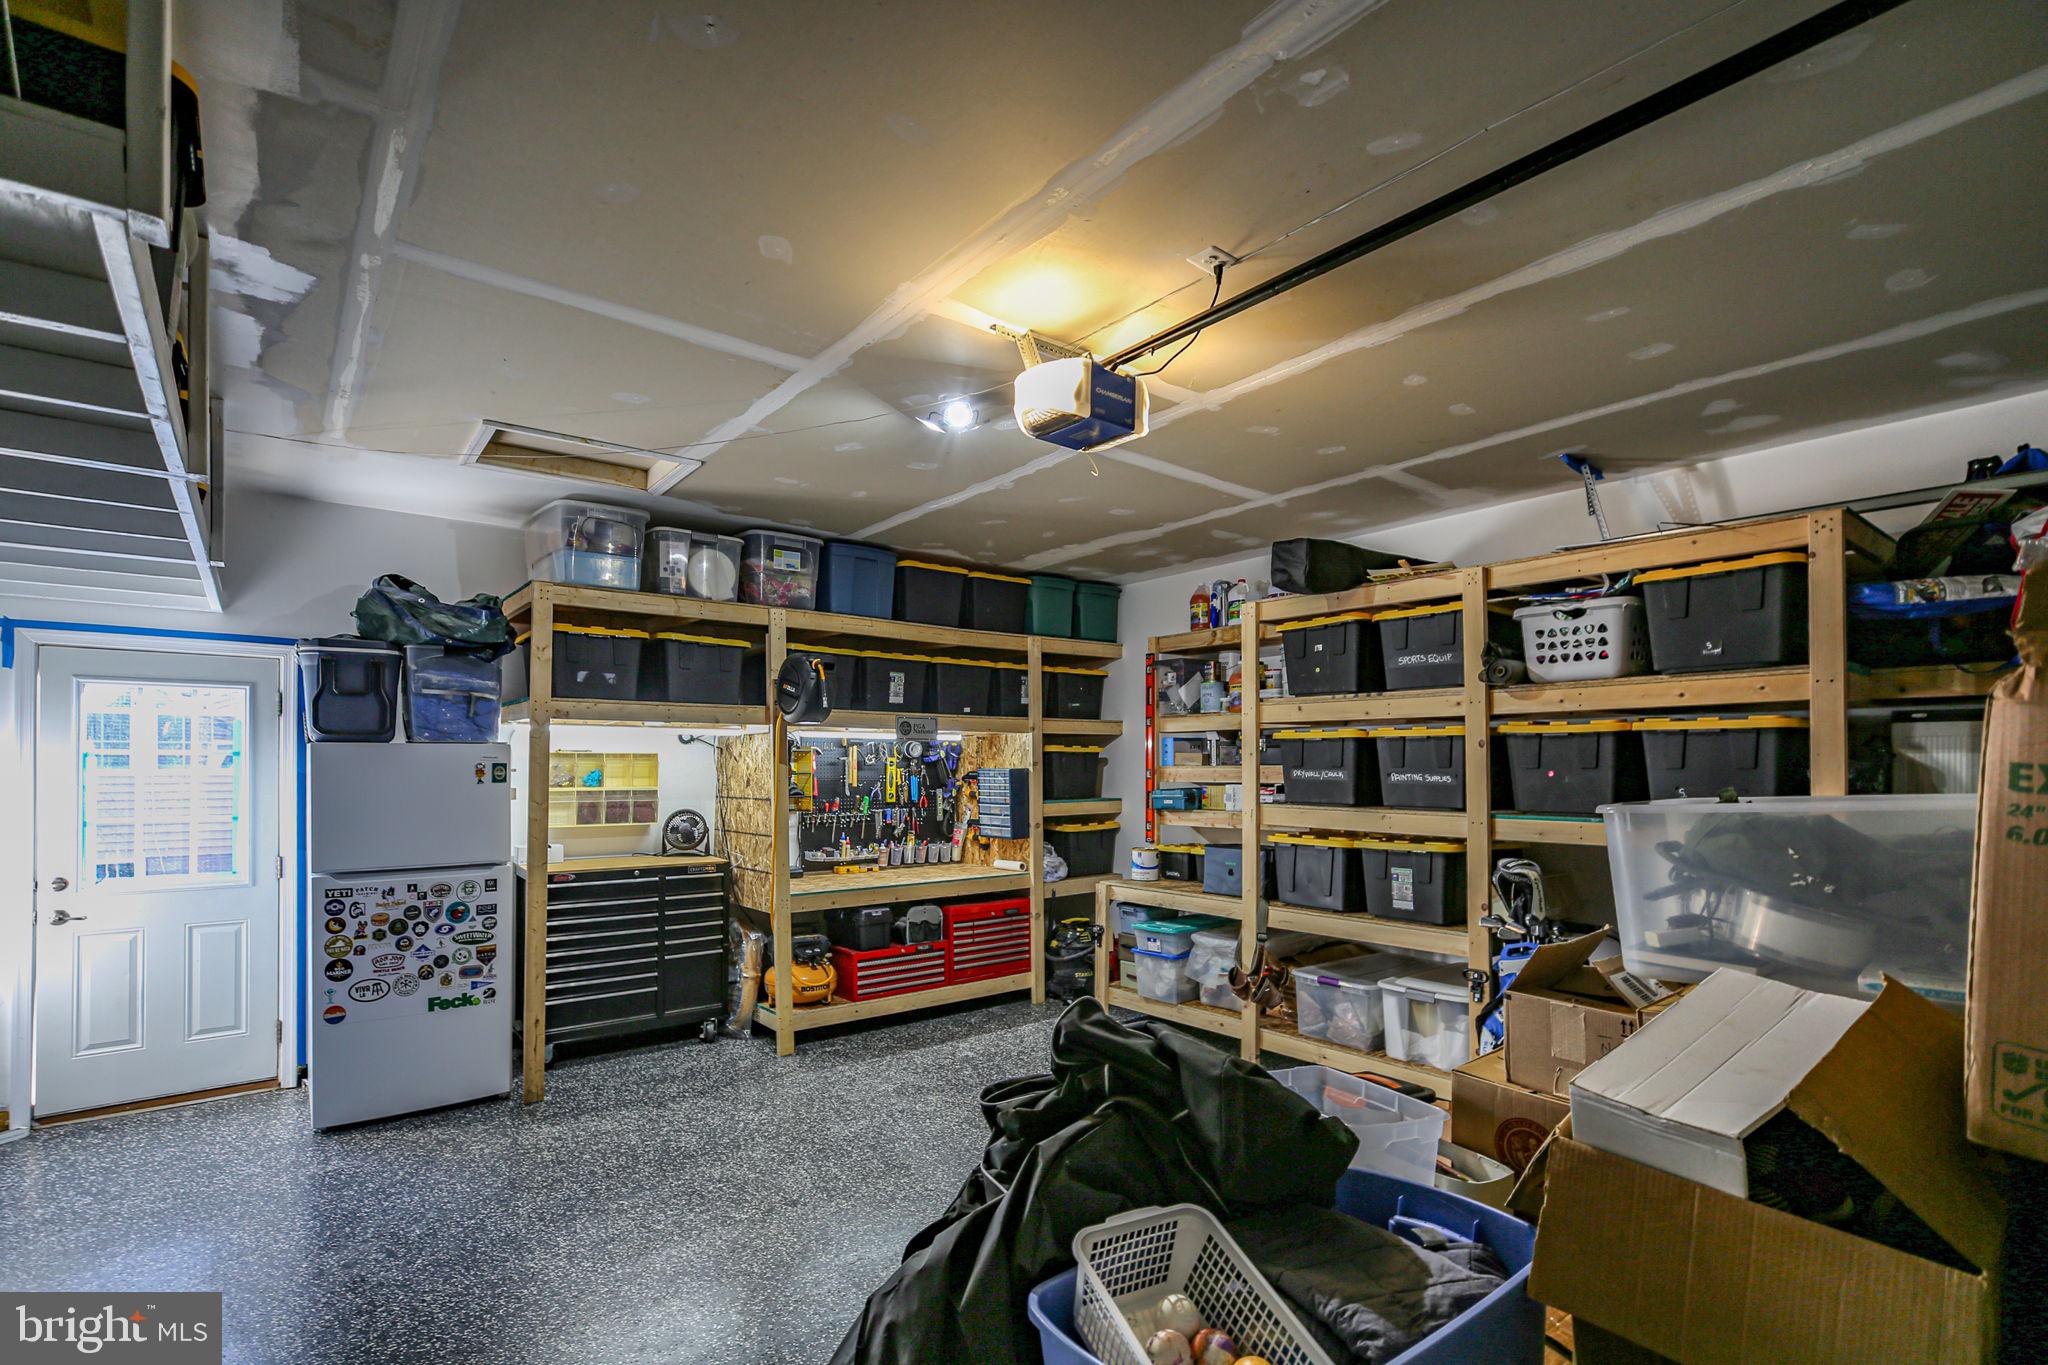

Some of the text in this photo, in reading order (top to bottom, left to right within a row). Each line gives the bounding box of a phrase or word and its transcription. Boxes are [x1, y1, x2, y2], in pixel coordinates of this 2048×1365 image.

[1096, 387, 1133, 404] CHAMBERLAIN
[1398, 653, 1452, 665] SPORTS EQUIP
[1425, 774, 1452, 783] SUPPLIES
[327, 889, 351, 898] YETI
